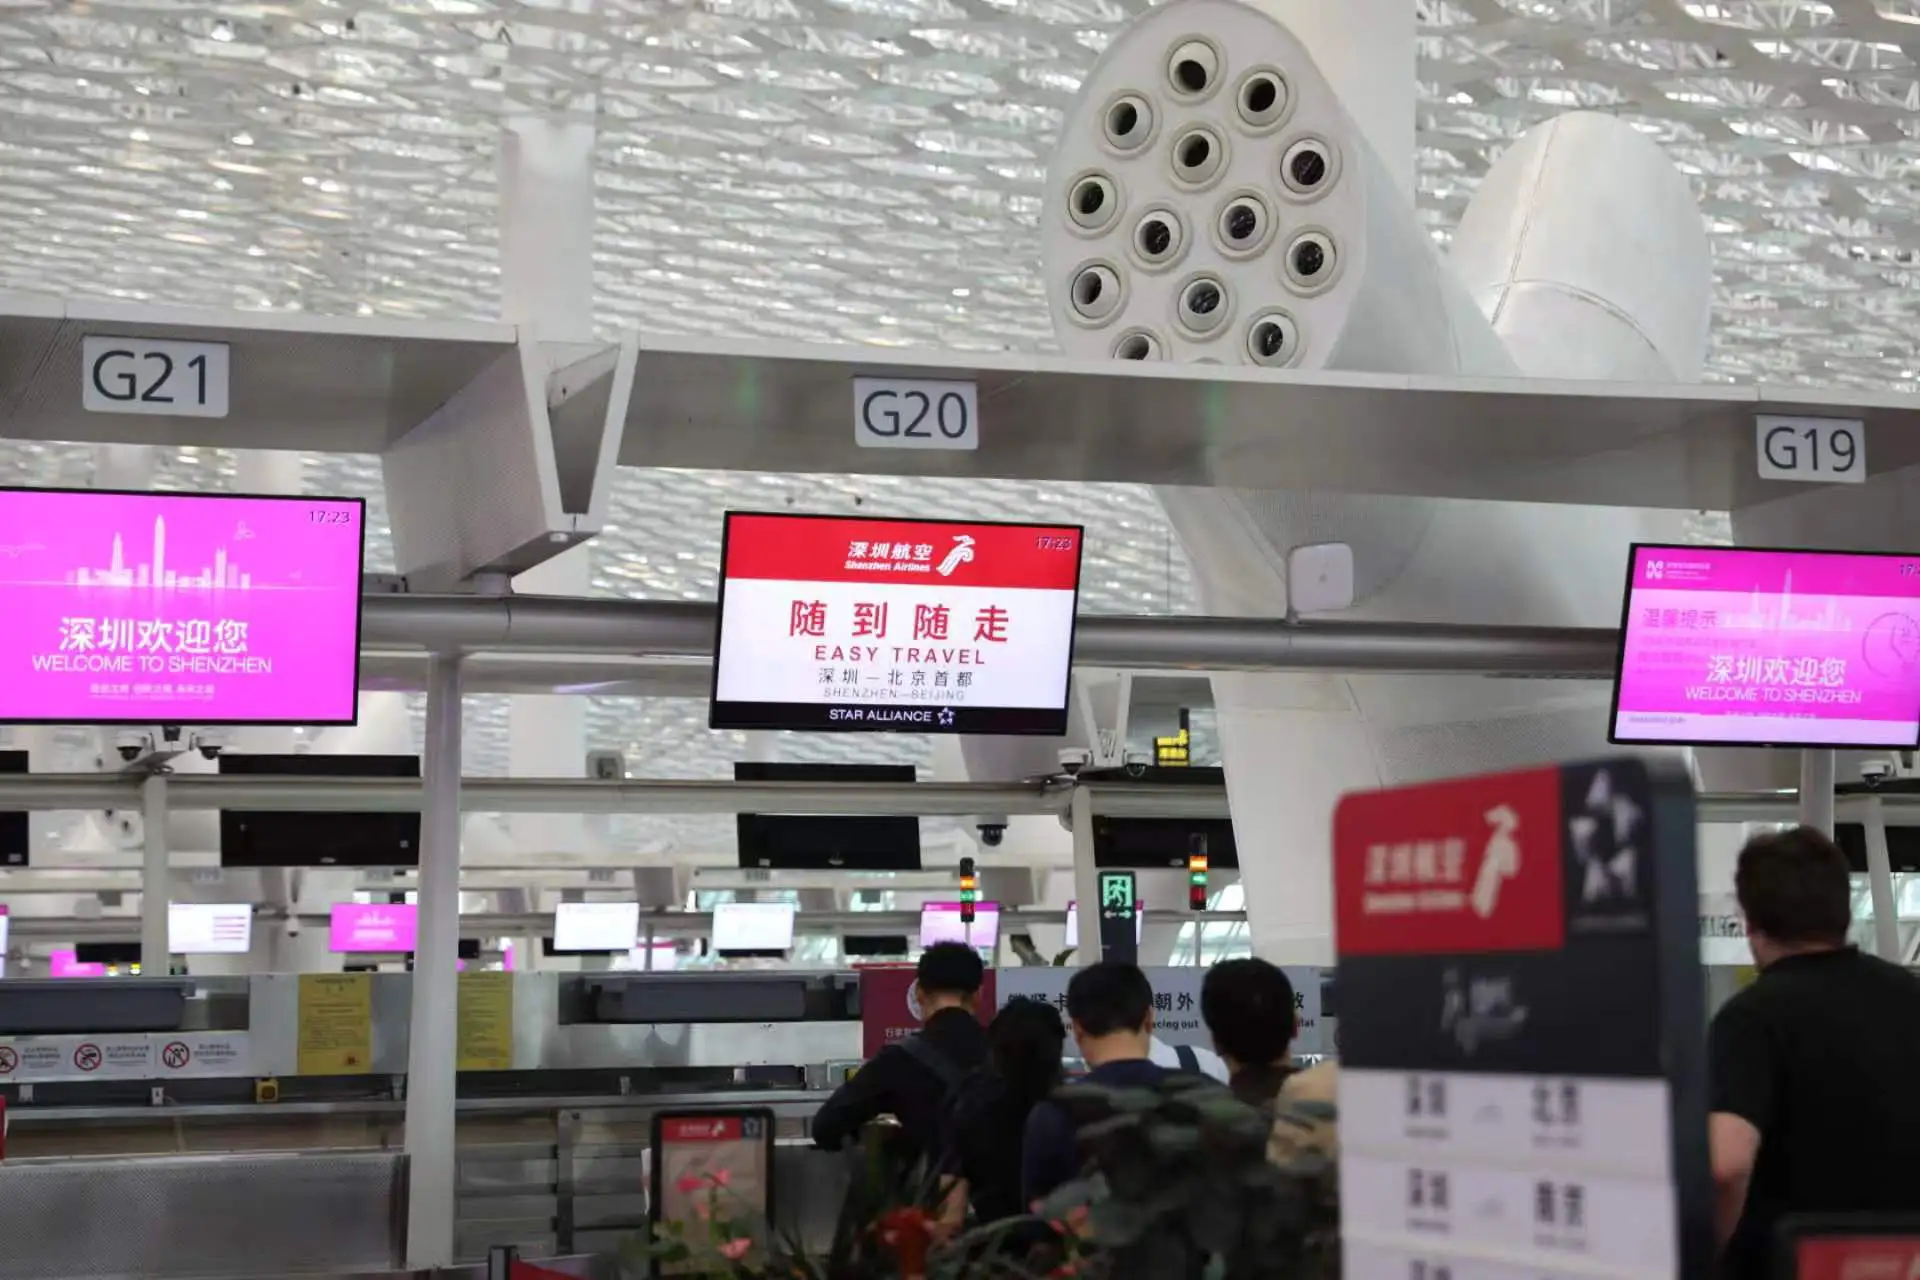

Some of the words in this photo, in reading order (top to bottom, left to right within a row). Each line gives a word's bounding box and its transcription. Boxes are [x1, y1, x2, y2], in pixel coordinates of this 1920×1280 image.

[92, 349, 206, 405] G21
[862, 389, 968, 439] G20
[1764, 426, 1855, 472] G19
[309, 510, 350, 524] 17:23
[847, 541, 933, 561] 深圳航空
[1036, 535, 1073, 551] 17:23
[844, 560, 891, 571] Shenzhen
[893, 562, 931, 573] Airlines
[789, 599, 1010, 643] 随到随走
[58, 617, 249, 654] 深圳欢迎您
[32, 654, 133, 672] WELCOME
[139, 655, 164, 673] TO
[168, 656, 272, 674] SHENZHEN
[815, 645, 879, 662] EASY
[893, 646, 986, 665] TRAVEL
[1705, 654, 1847, 687] 深圳欢迎您
[1686, 686, 1758, 702] WELCOME
[1763, 687, 1782, 702] TO
[1784, 688, 1862, 704] SHENZHEN
[828, 708, 863, 721] STAR
[865, 709, 933, 722] ALLIANCE
[1181, 1020, 1199, 1029] out
